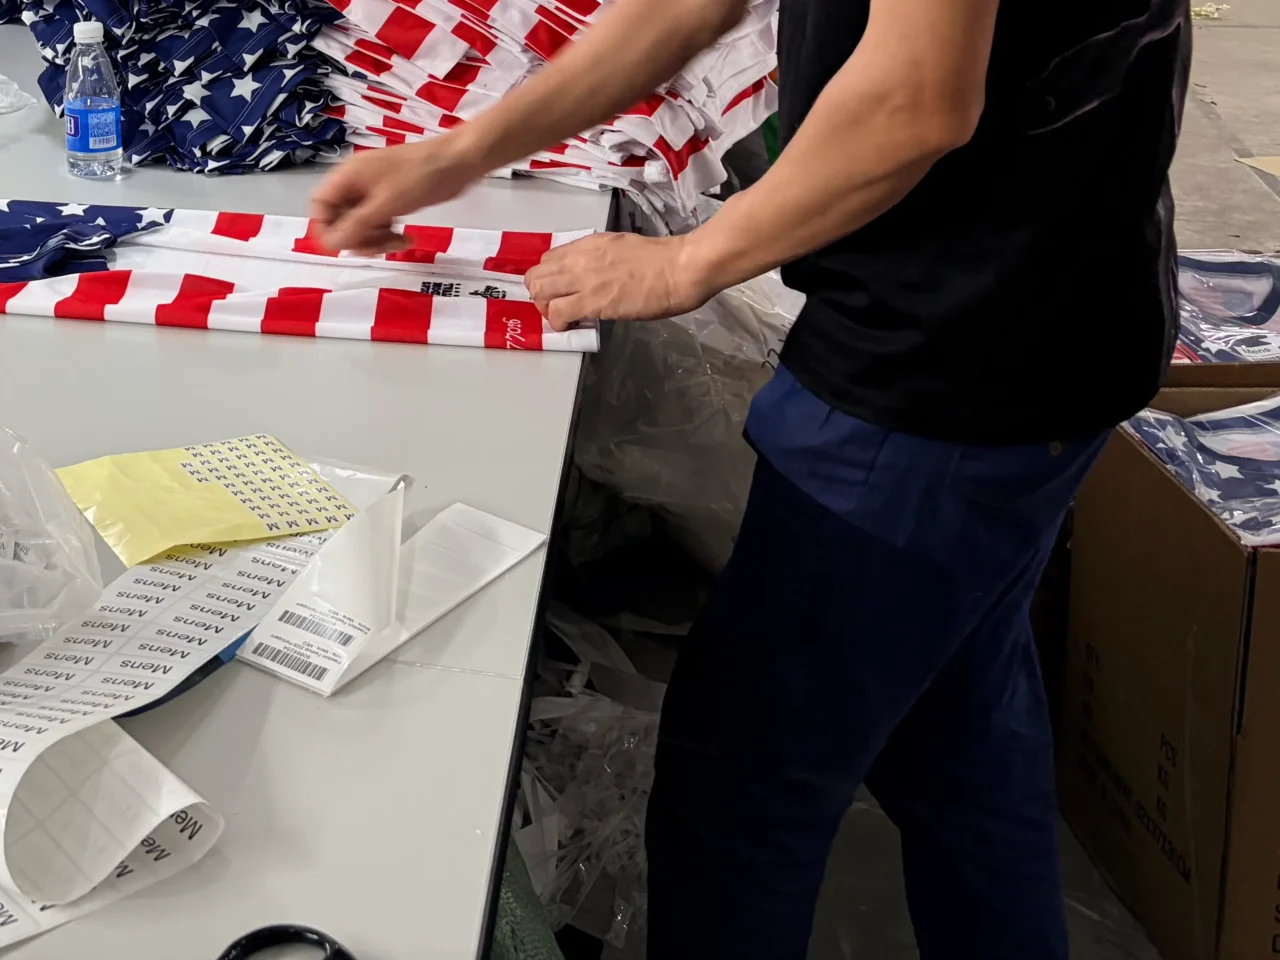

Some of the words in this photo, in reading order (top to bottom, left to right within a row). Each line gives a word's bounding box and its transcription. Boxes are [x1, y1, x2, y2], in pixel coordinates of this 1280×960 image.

[186, 543, 228, 558] Men
[165, 552, 214, 571] Mens
[251, 556, 299, 576] Mens
[149, 565, 198, 582] Mens
[236, 569, 287, 588] Mens
[133, 577, 182, 593] Mens
[221, 582, 272, 600] Mens
[116, 590, 166, 605] Mens
[205, 591, 257, 612] Mens
[98, 603, 149, 618] Mens
[189, 602, 241, 623] Mens
[80, 620, 131, 633] Mens
[172, 614, 225, 634] Mens
[62, 636, 114, 650] Mens
[155, 627, 209, 647] Mens
[43, 651, 95, 666] Mens
[137, 642, 192, 660] Mens
[23, 667, 76, 681] Mens
[119, 658, 173, 675] Mens
[3, 680, 56, 693] Mens
[100, 676, 156, 691] Mens
[80, 688, 136, 701] Mens
